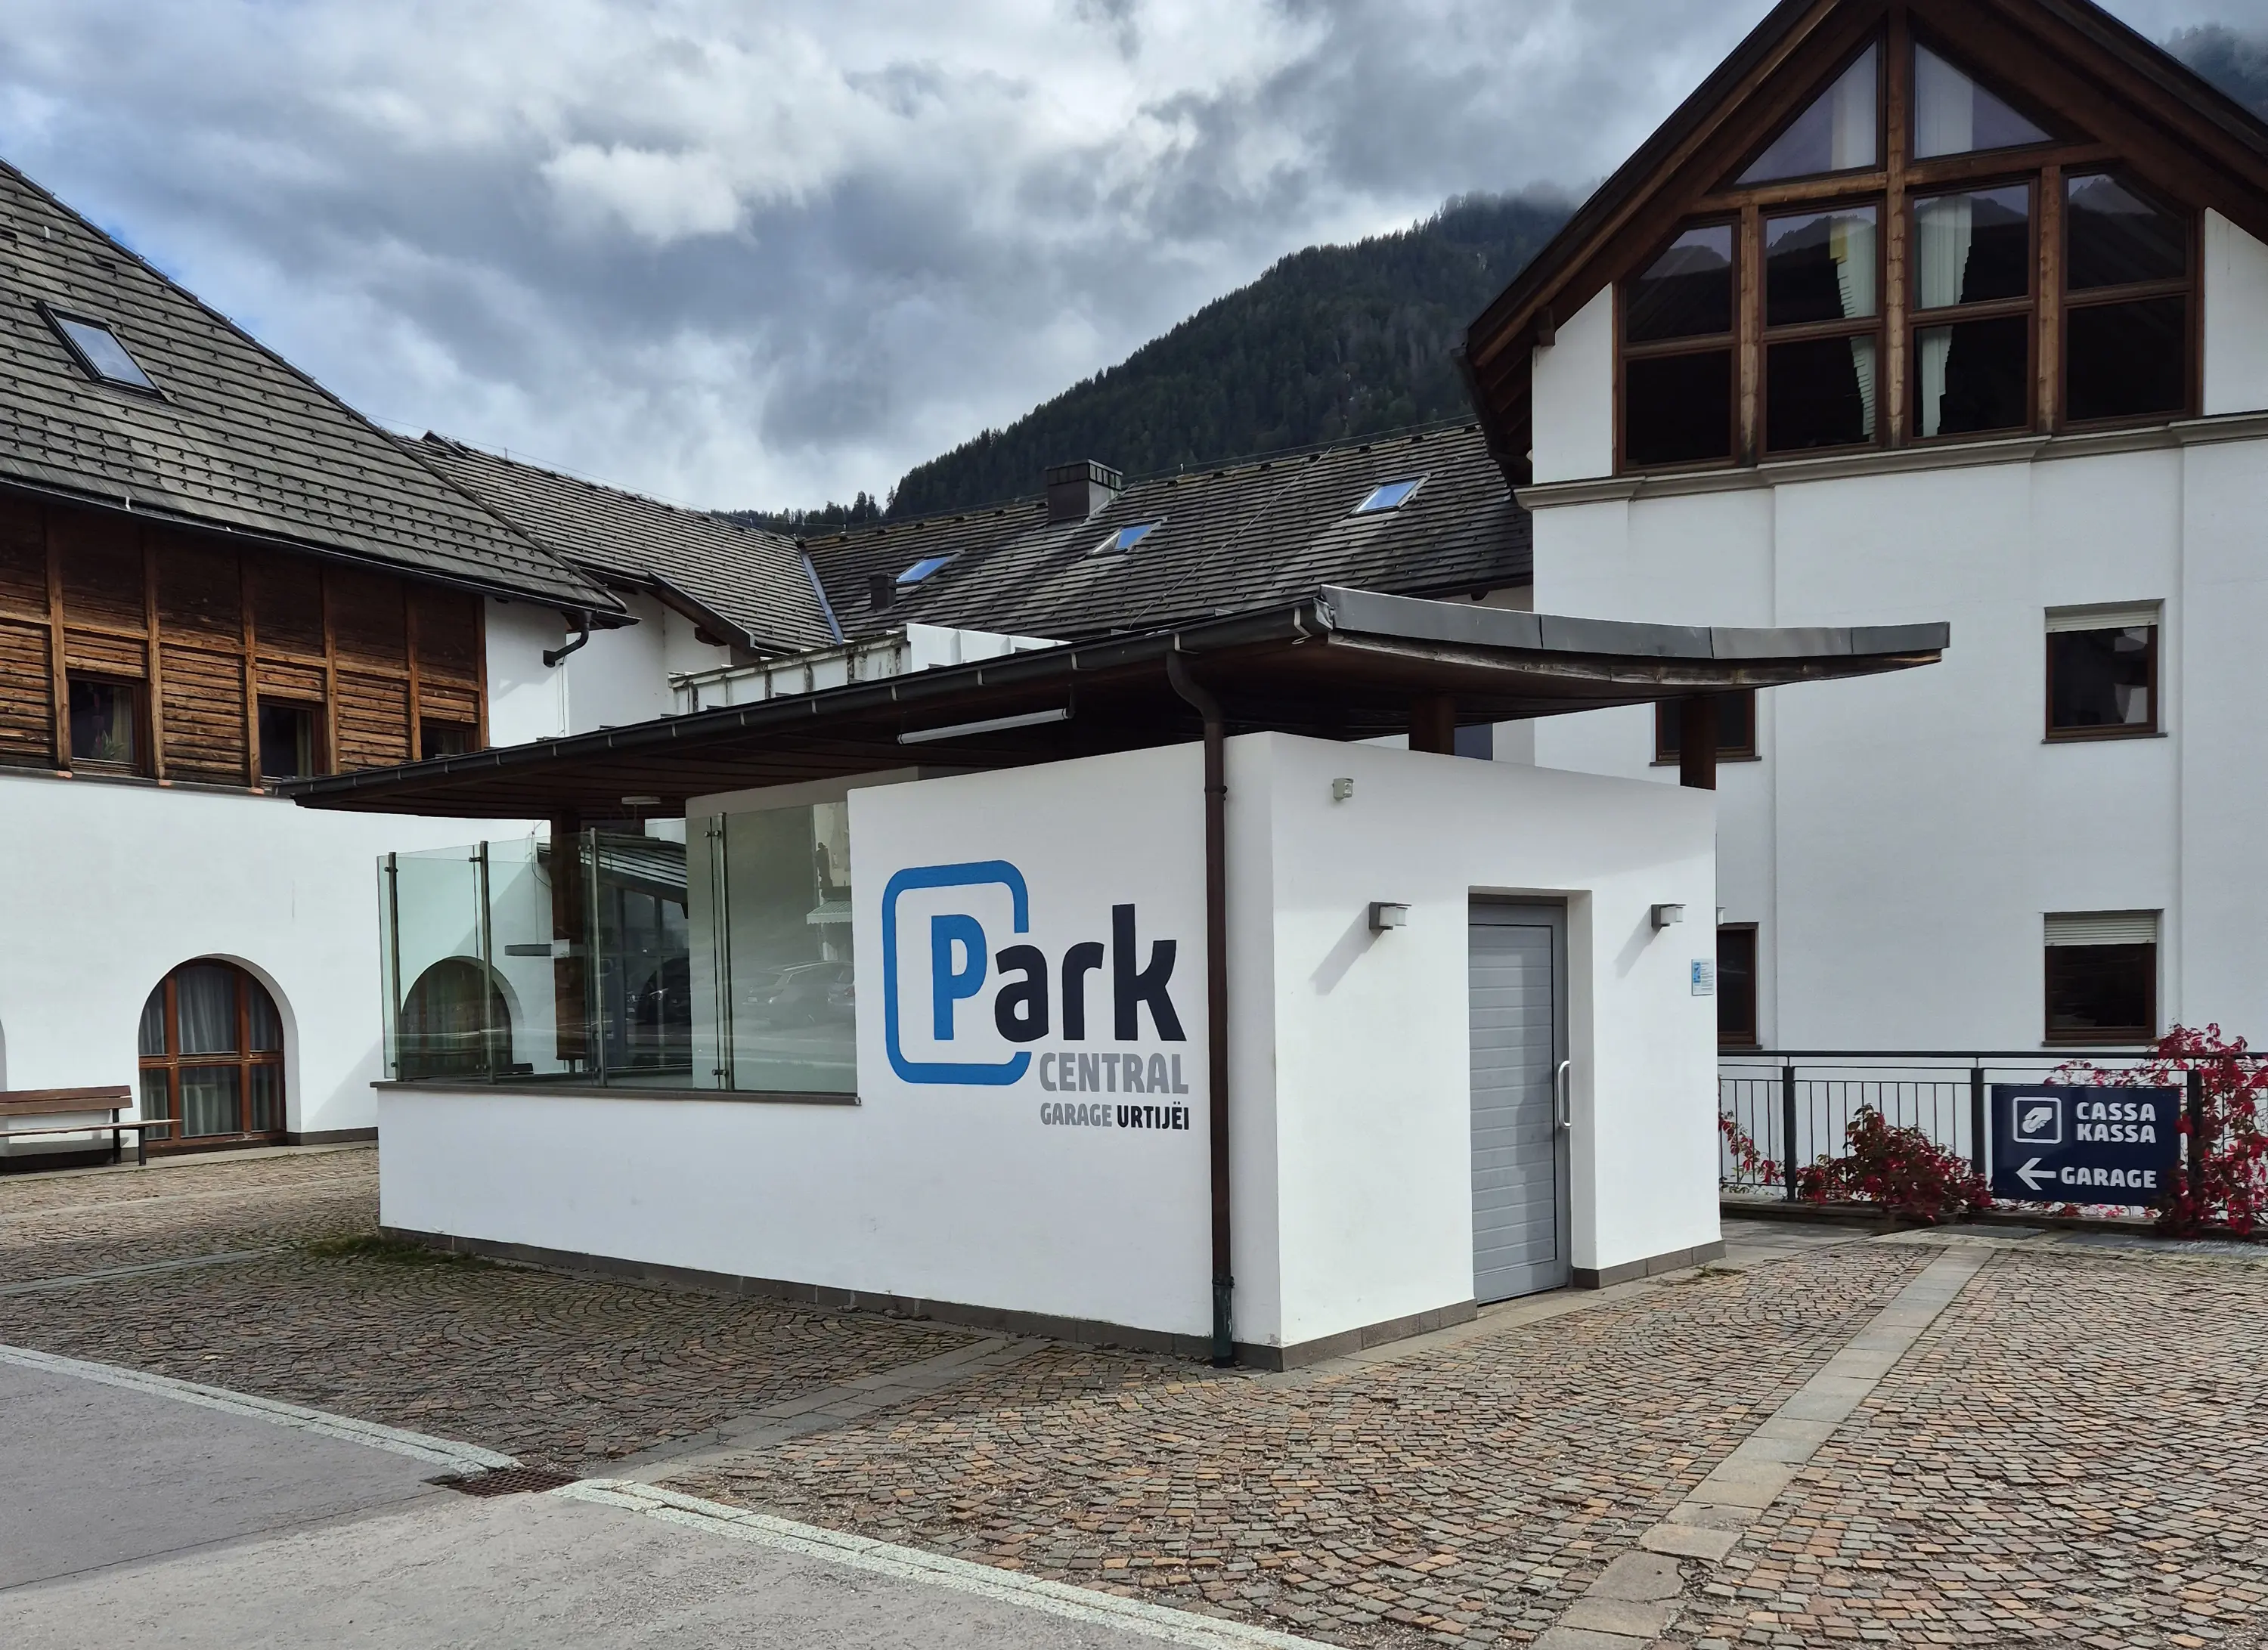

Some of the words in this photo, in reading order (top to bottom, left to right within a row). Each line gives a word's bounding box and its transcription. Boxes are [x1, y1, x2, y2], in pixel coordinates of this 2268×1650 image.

[931, 903, 1187, 1042] Park
[1040, 1052, 1189, 1094] CENTRAL
[1040, 1102, 1112, 1126] GARAGE
[1117, 1101, 1189, 1129] URTIJËI
[2076, 1101, 2156, 1122] CASSA
[2077, 1123, 2157, 1144] KASSA
[2061, 1166, 2157, 1188] GARAGE
